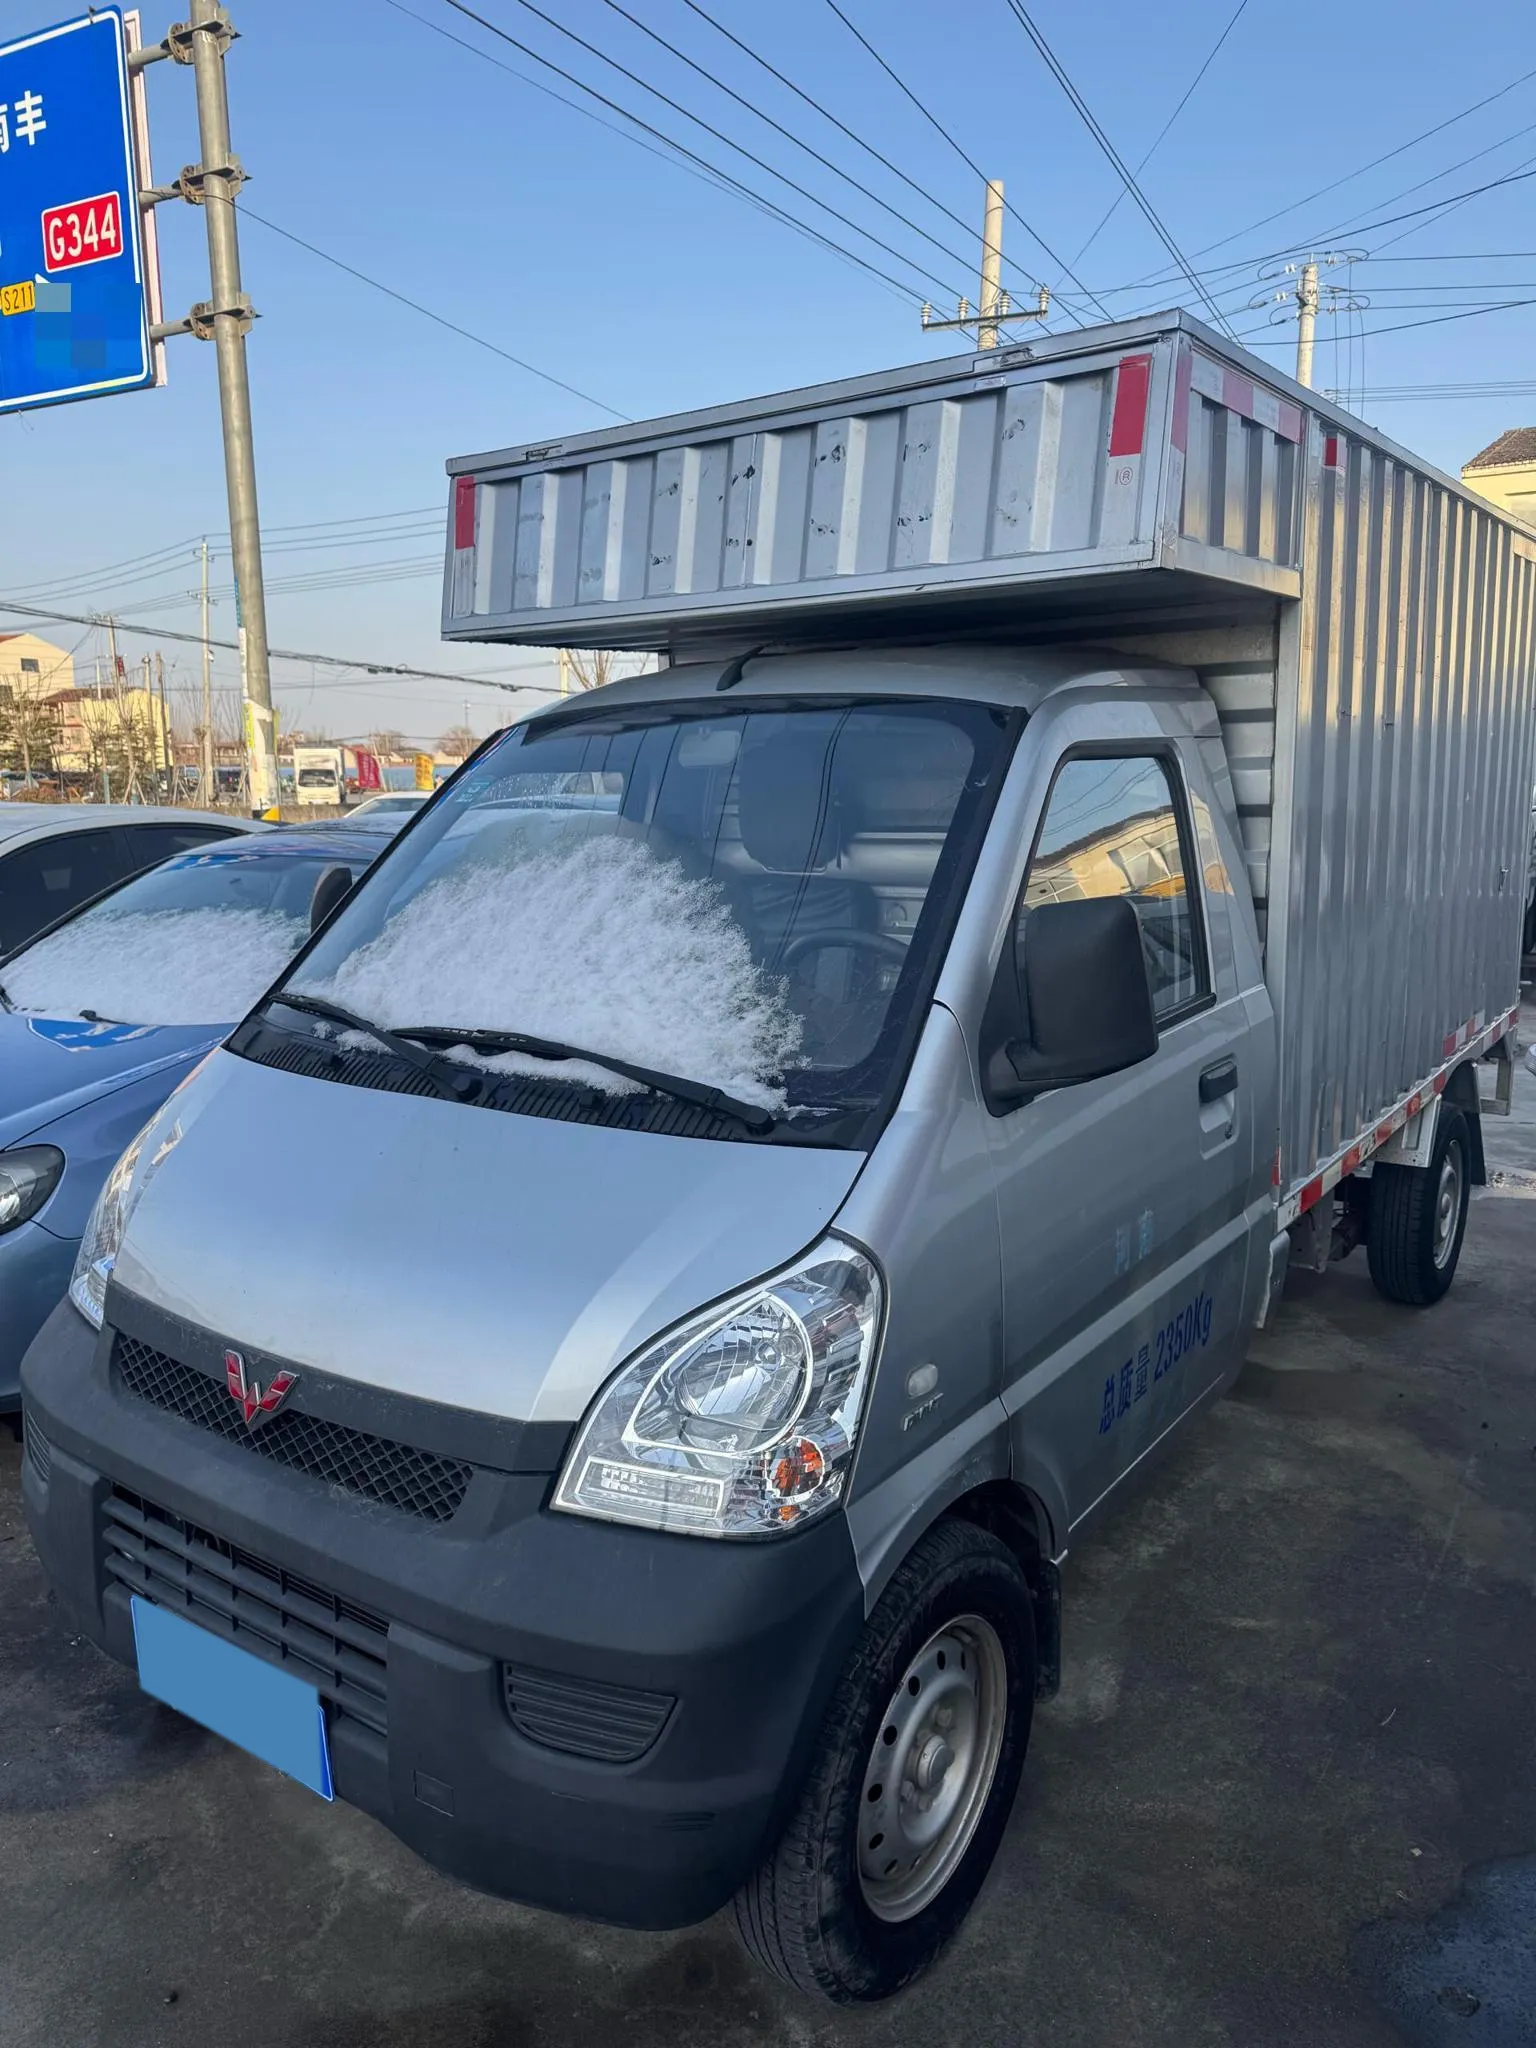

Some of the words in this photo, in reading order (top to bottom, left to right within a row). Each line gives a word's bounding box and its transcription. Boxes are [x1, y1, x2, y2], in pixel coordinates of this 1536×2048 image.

[0, 90, 46, 153] 丰
[49, 203, 116, 261] G344
[4, 285, 33, 311] S211
[1100, 1345, 1150, 1434] 总质量
[1154, 1292, 1212, 1384] 2350Kg
